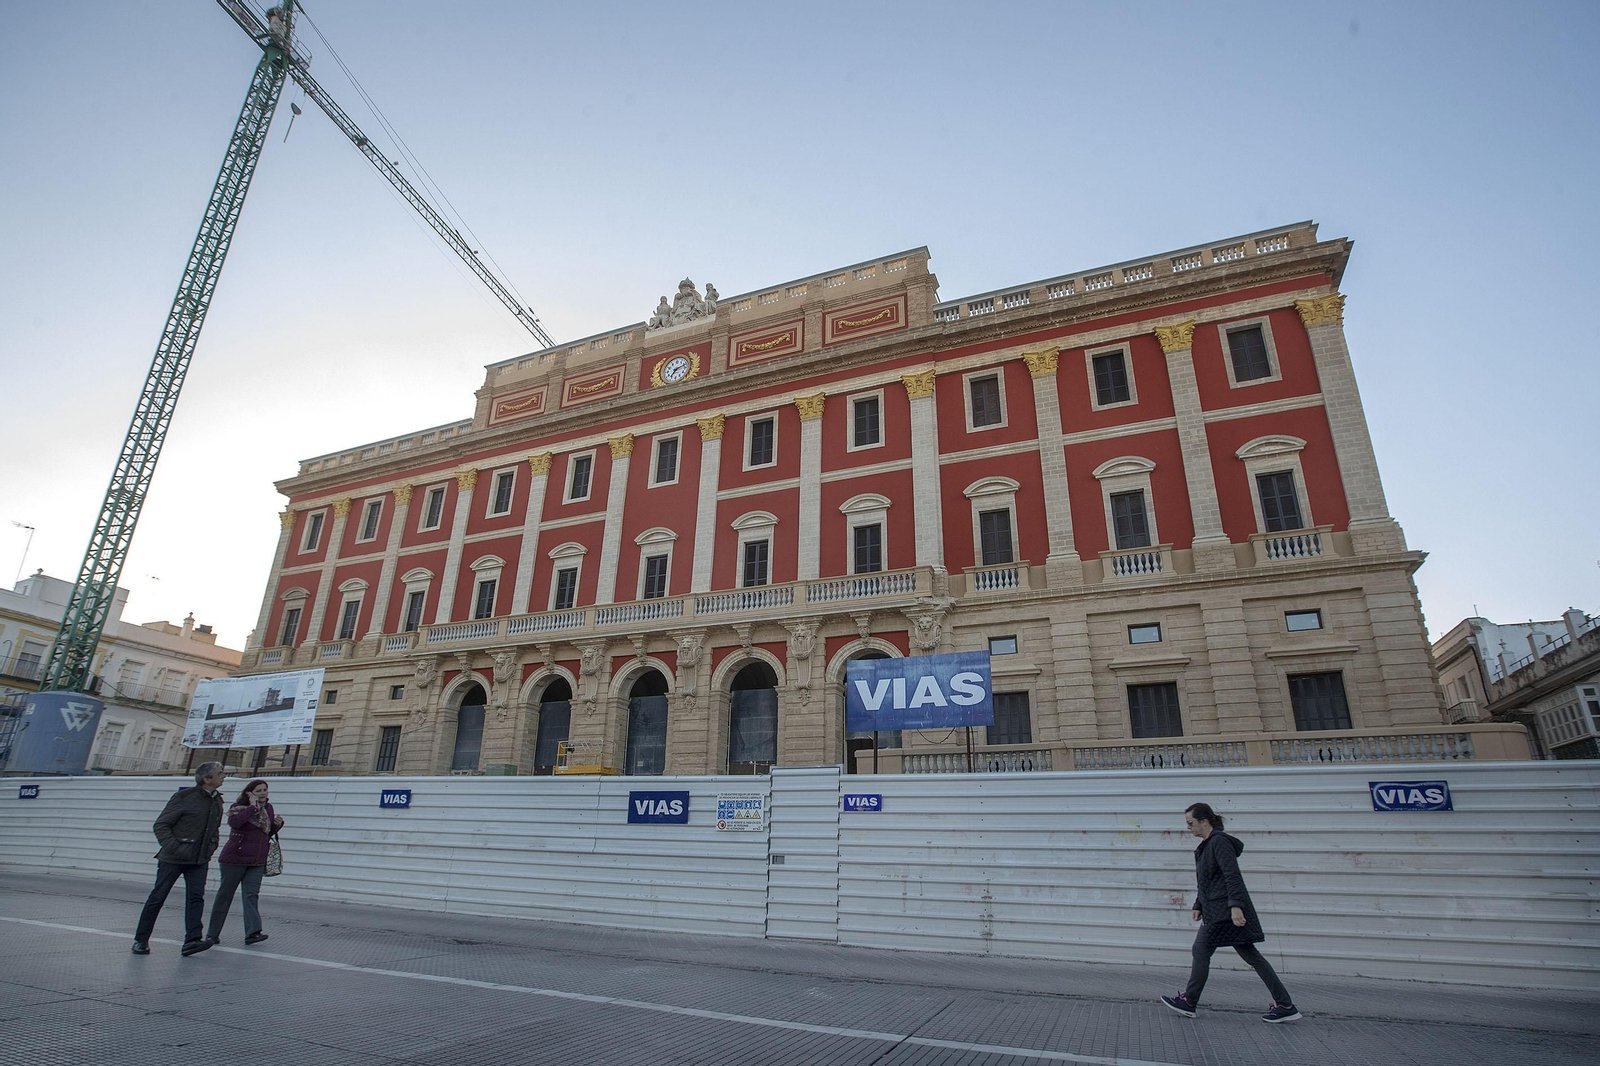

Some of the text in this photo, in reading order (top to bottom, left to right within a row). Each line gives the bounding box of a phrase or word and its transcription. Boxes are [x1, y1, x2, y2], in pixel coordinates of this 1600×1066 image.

[854, 671, 986, 711] VIAS
[20, 788, 37, 796] VIAS
[1377, 788, 1444, 804] VIAS
[383, 794, 408, 804] VIAS
[847, 797, 878, 807] VIAS
[634, 799, 684, 816] VIAS
